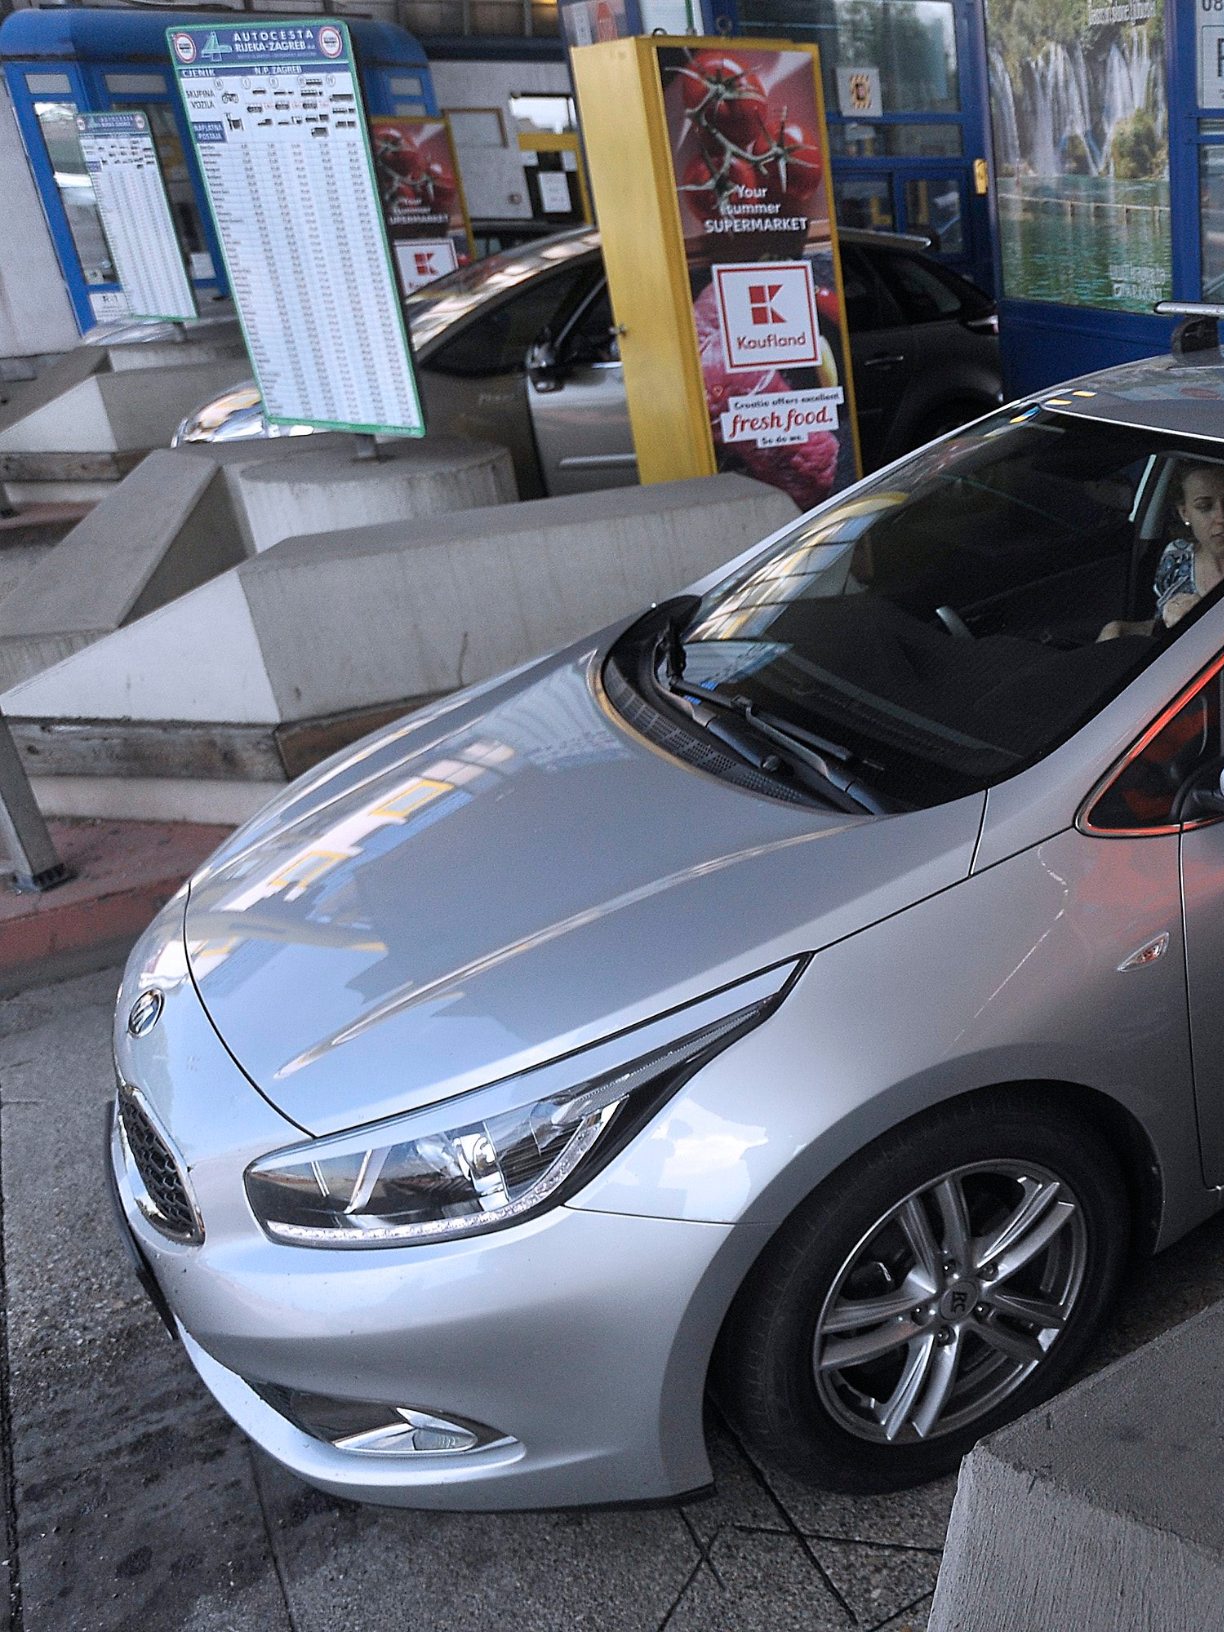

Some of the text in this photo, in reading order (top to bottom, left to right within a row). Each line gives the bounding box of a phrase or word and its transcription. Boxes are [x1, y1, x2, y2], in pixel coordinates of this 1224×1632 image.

[234, 29, 314, 42] AUTOCESTA
[234, 40, 306, 52] RIJEKA-ZAGREB
[182, 69, 216, 77] CJENIK
[271, 65, 302, 74] ZAGREB
[186, 90, 215, 98] SKUPINA
[191, 100, 215, 109] VOZILA
[736, 184, 768, 199] Your
[726, 203, 781, 214] summer
[389, 213, 449, 225] UPERMARKET
[704, 217, 808, 233] SUPERMARKET
[736, 331, 807, 350] Kaufland
[734, 392, 839, 411] Croatia offers excellent
[729, 405, 833, 438] fresh food.
